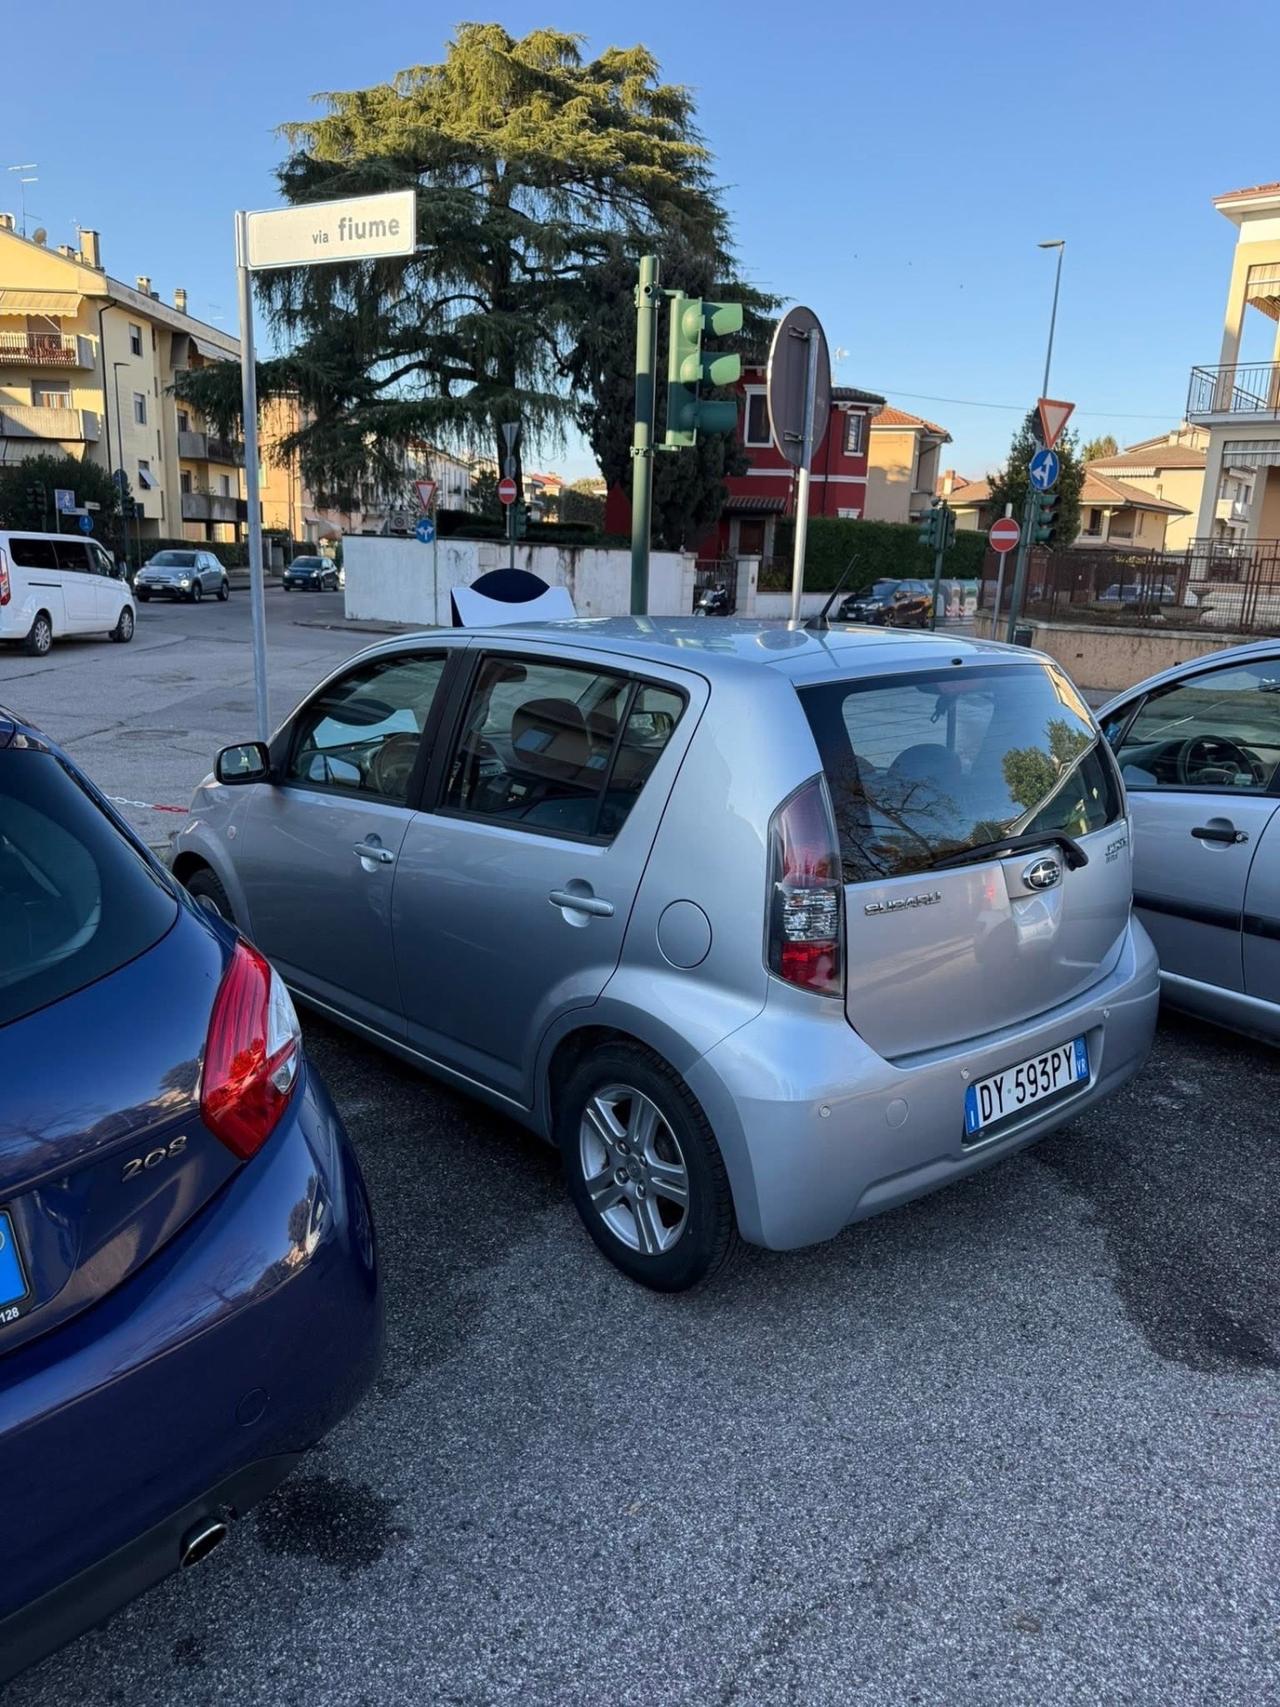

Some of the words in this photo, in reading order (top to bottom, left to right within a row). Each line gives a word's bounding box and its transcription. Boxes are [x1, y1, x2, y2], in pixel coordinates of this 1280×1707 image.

[312, 230, 329, 245] via
[338, 217, 401, 242] fiume
[865, 891, 942, 917] SUBARU
[979, 1076, 1004, 1122] DY
[1015, 1045, 1073, 1104] 593PY
[121, 1135, 187, 1184] 208
